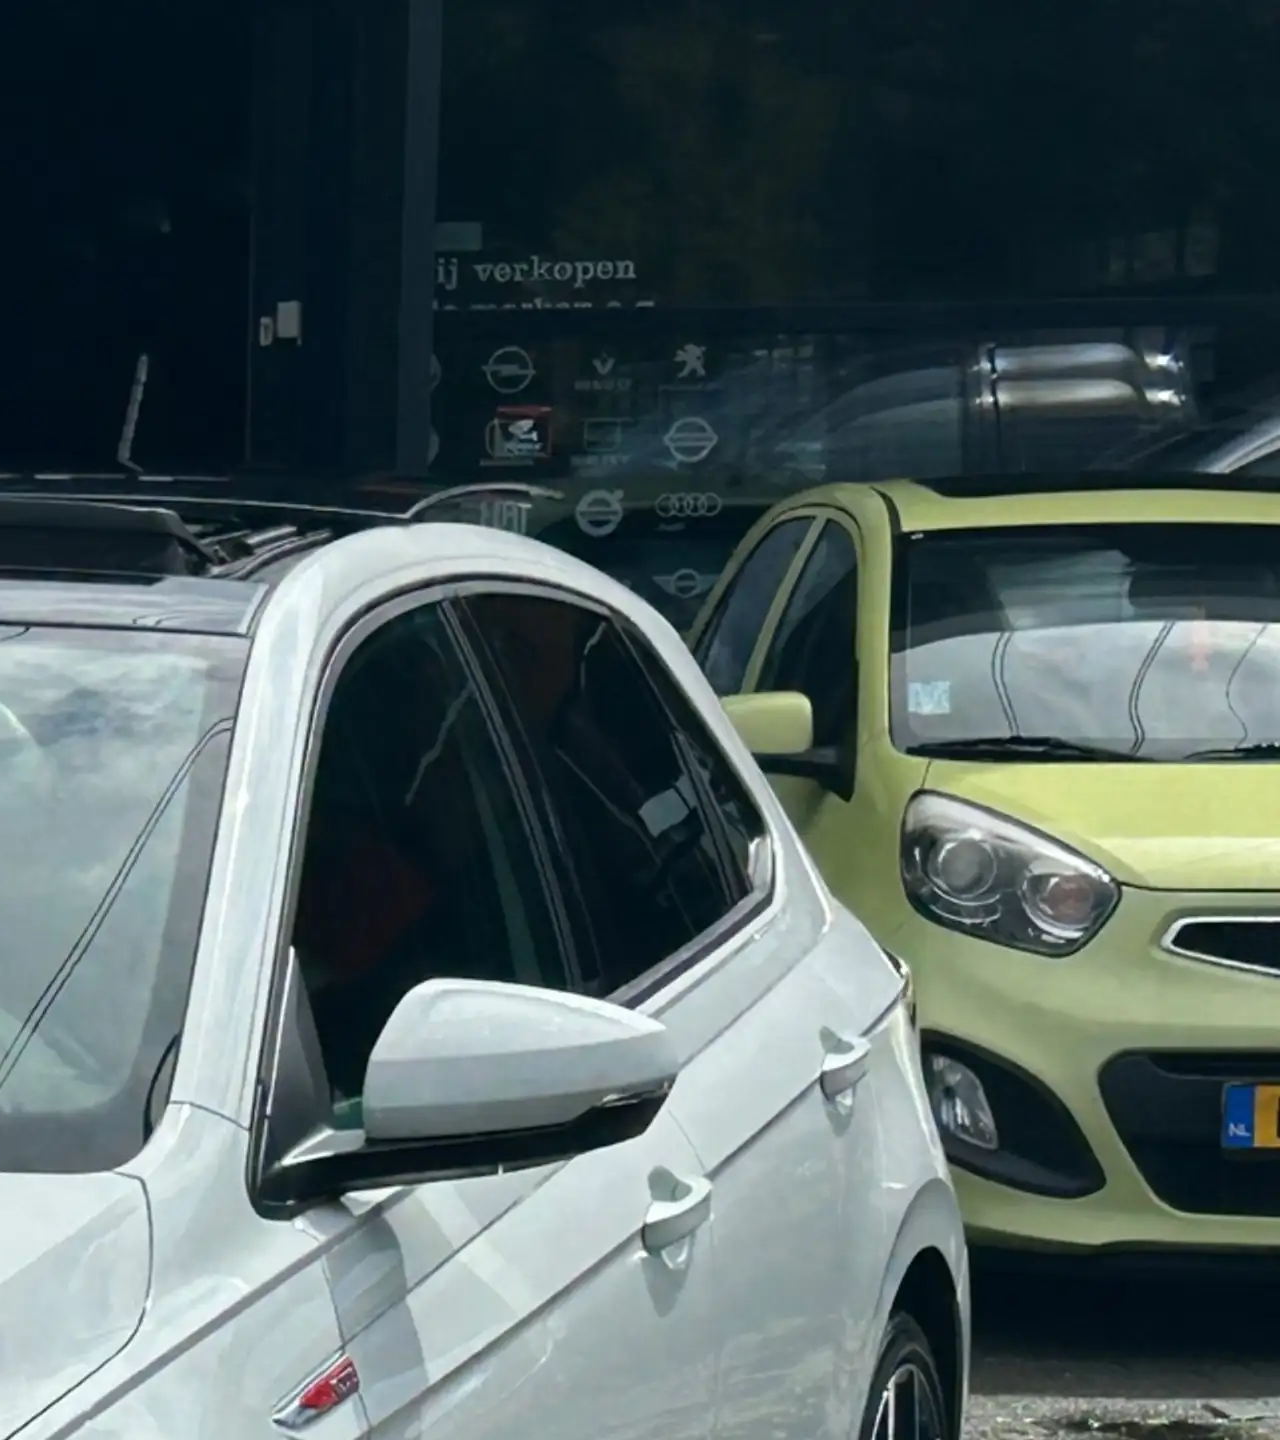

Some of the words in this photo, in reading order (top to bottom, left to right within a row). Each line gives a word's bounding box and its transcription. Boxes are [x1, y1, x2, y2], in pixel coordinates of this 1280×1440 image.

[436, 257, 458, 290] ij
[473, 255, 637, 289] verkopen
[1228, 1122, 1251, 1137] NL
